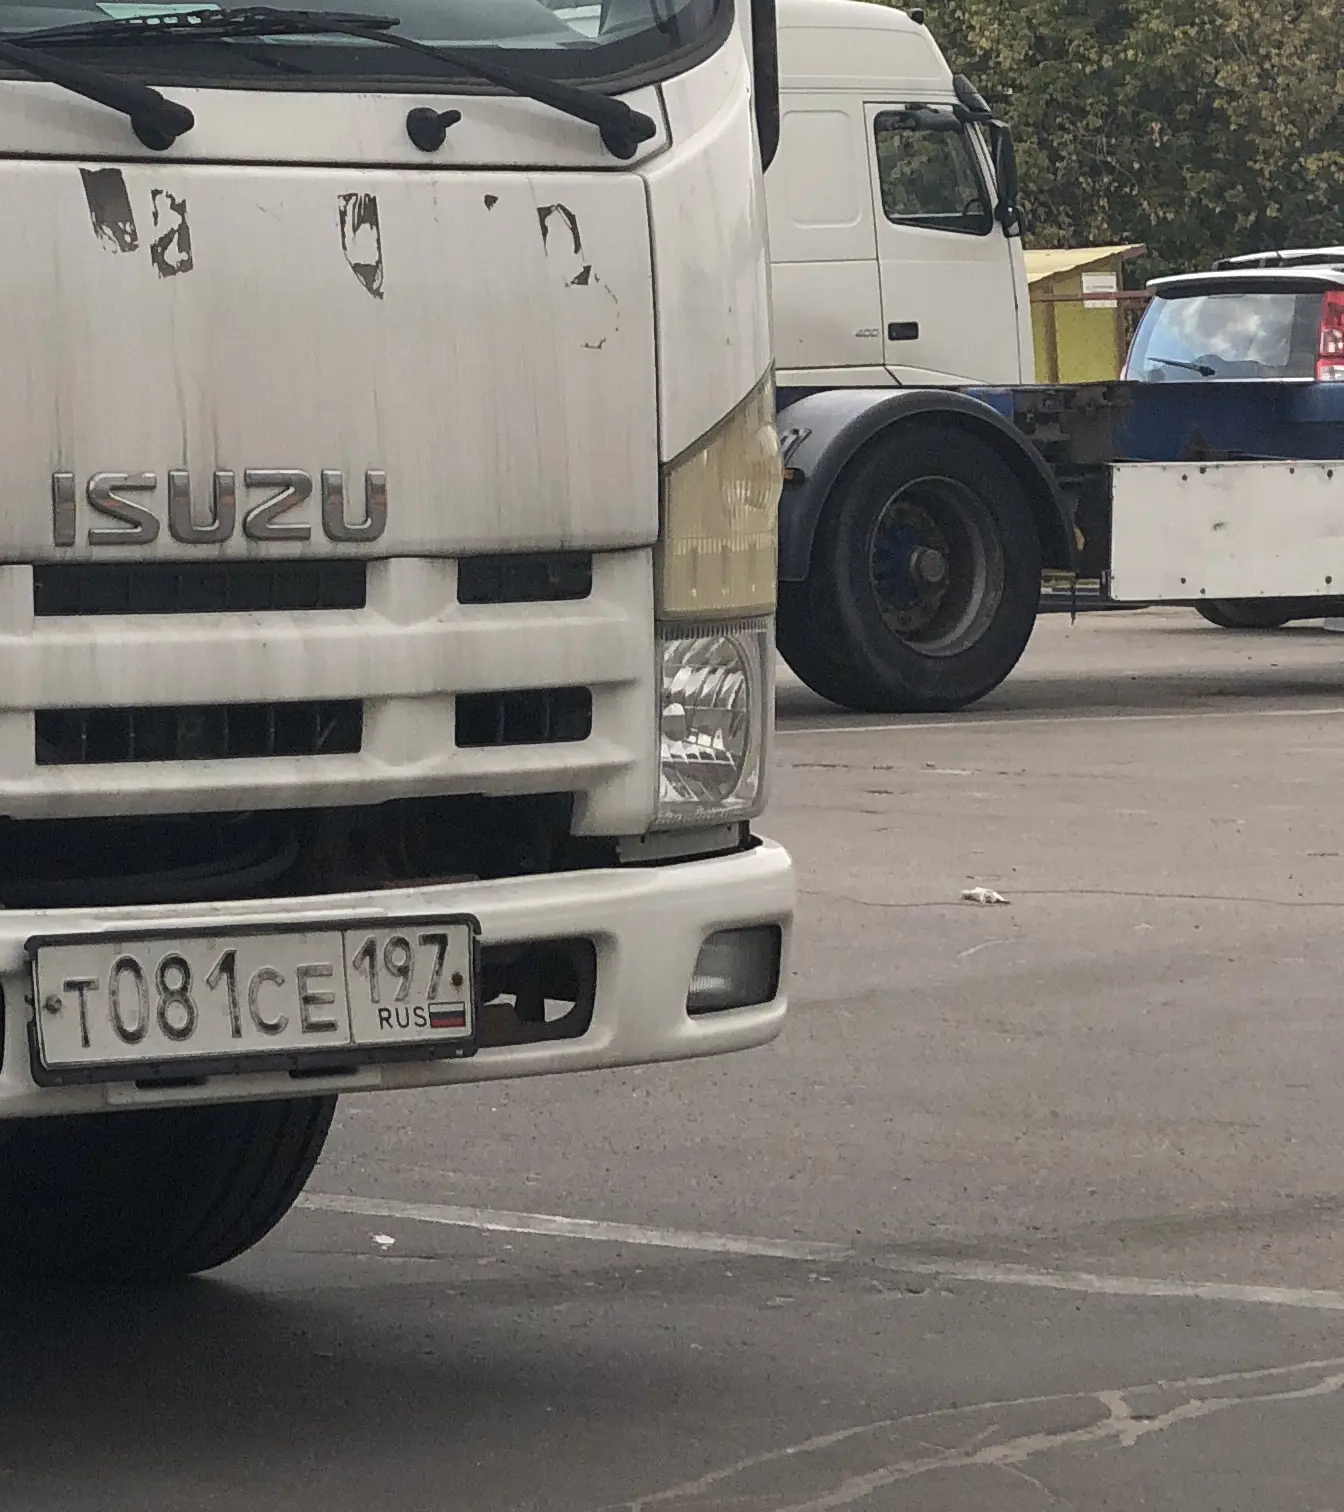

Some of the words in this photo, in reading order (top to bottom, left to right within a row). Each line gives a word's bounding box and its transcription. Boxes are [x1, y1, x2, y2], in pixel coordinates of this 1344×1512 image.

[51, 468, 388, 547] ISUZU
[351, 931, 450, 1004] 197
[377, 1003, 427, 1031] RUS
